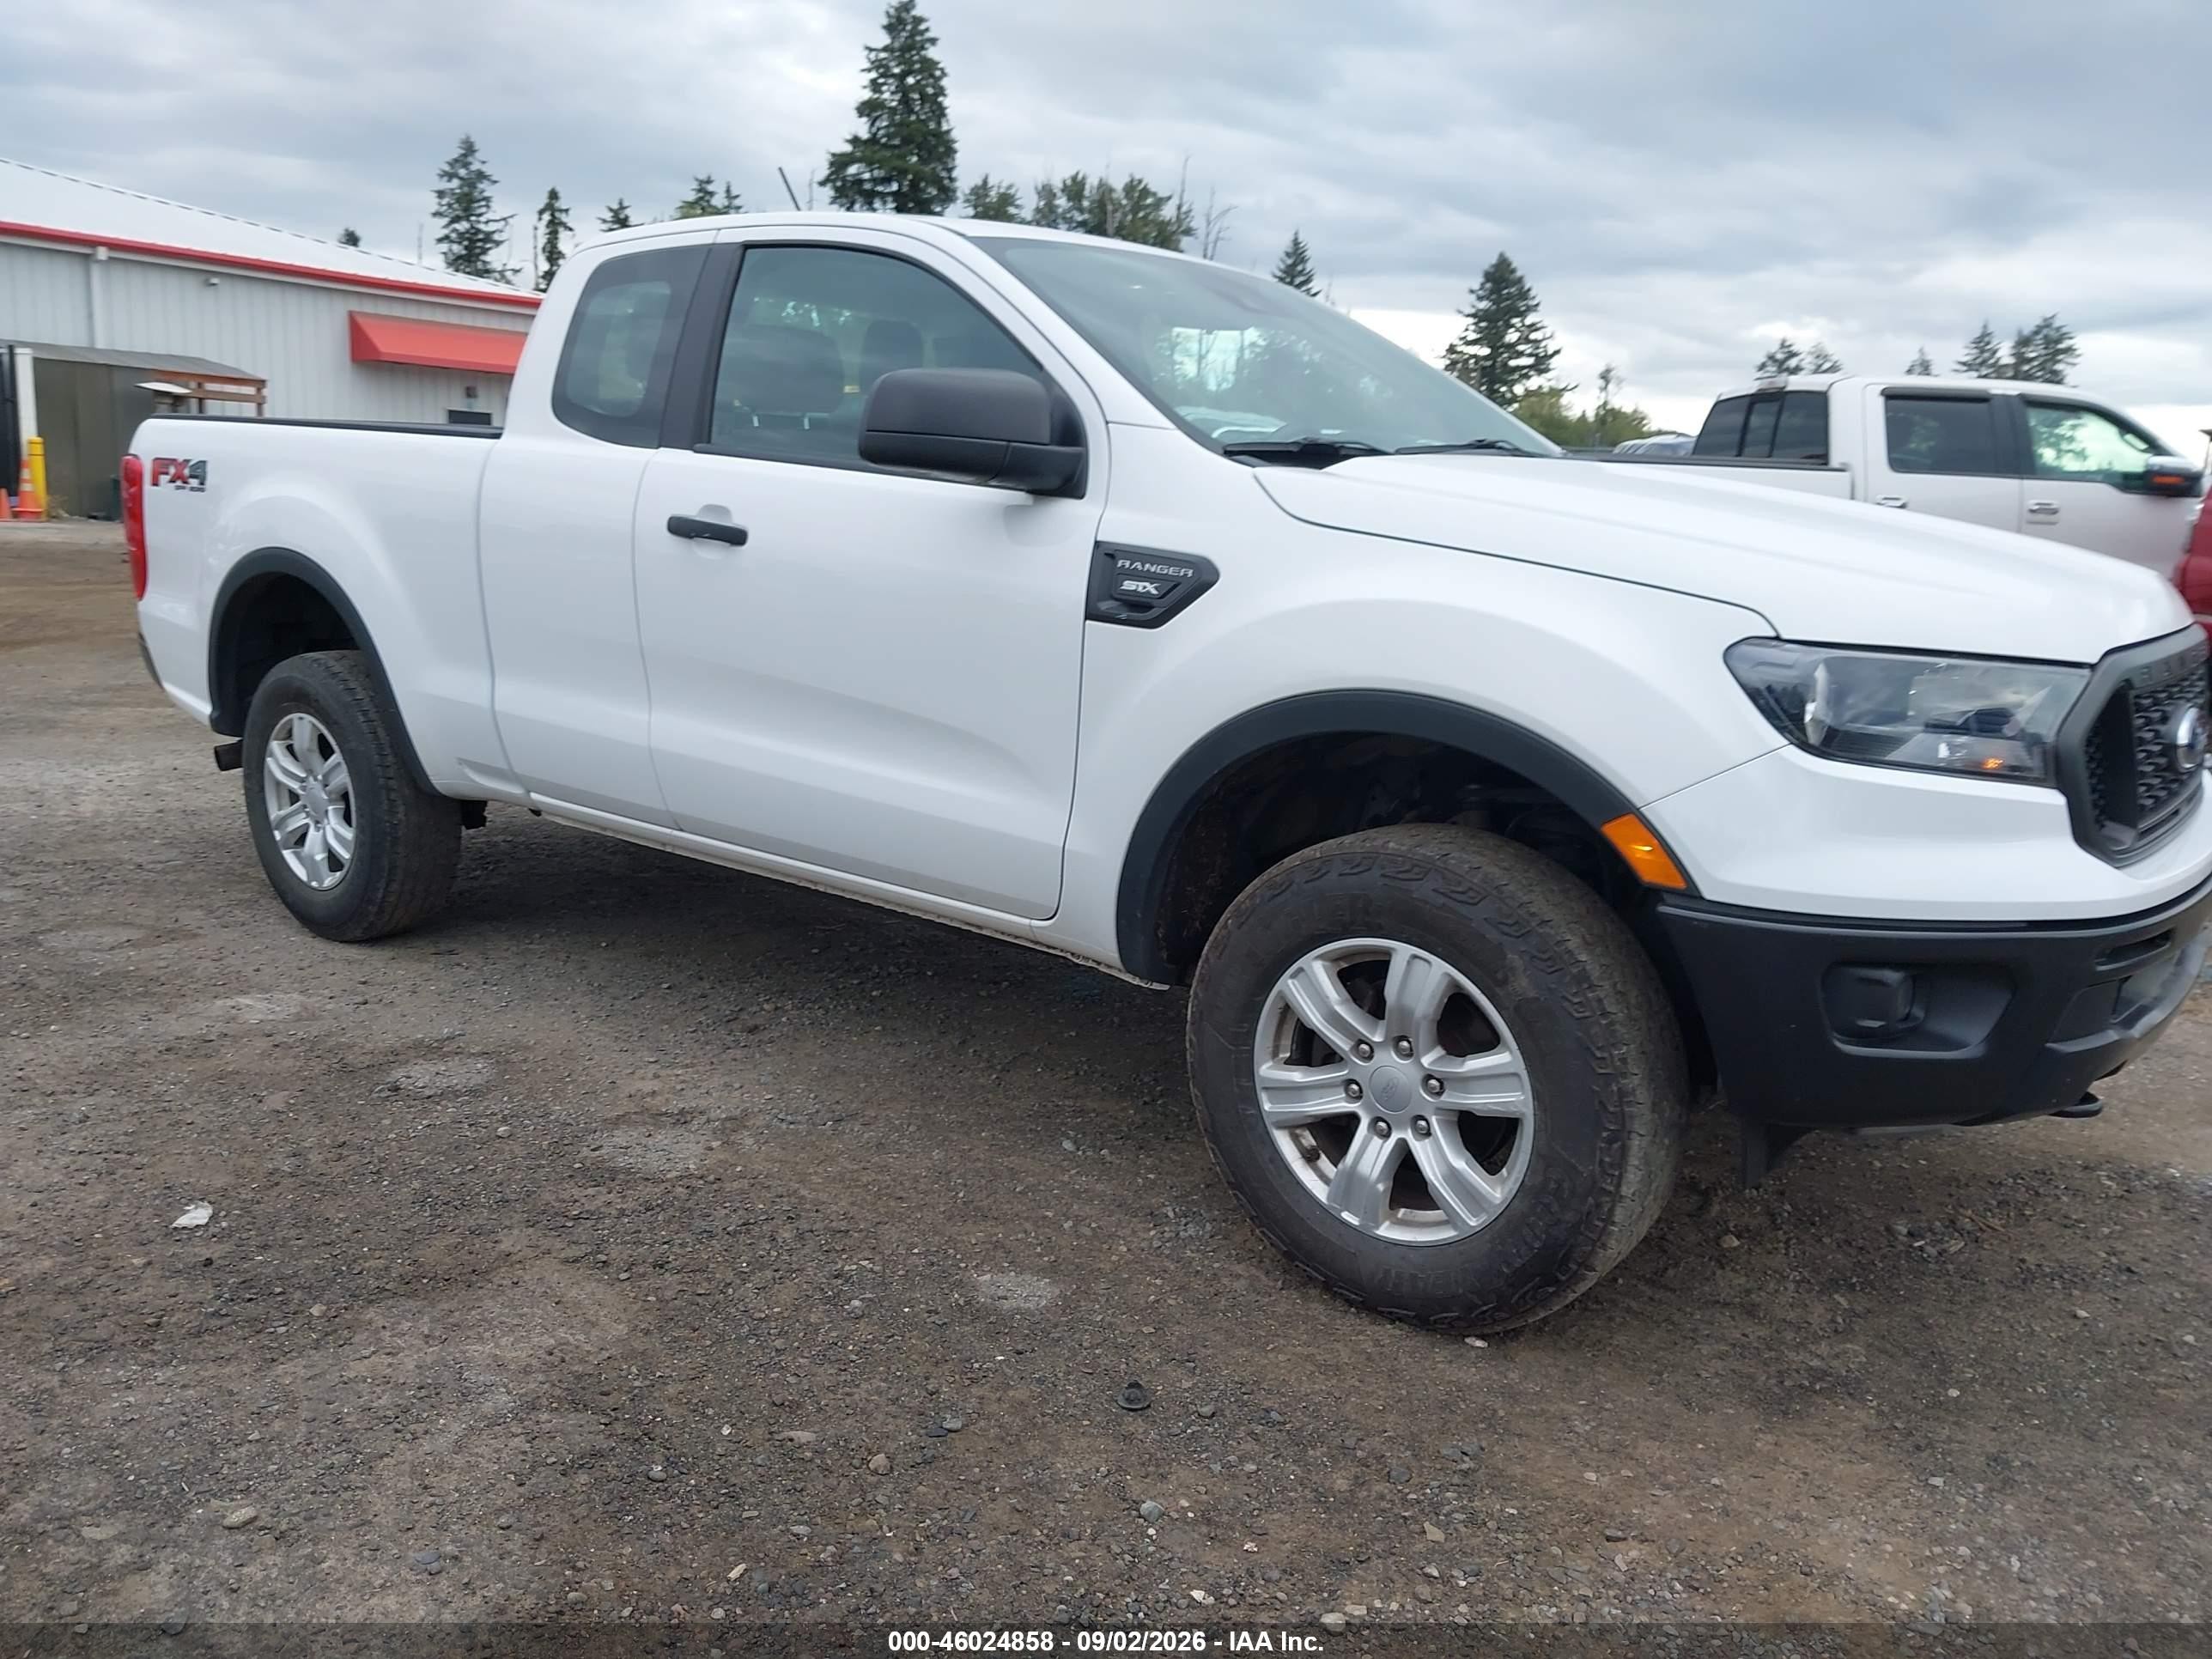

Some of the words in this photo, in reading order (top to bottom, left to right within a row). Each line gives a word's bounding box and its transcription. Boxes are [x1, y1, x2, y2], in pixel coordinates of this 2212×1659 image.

[151, 457, 208, 487] FX4
[1117, 559, 1194, 577] RANGER
[1120, 580, 1161, 594] STX
